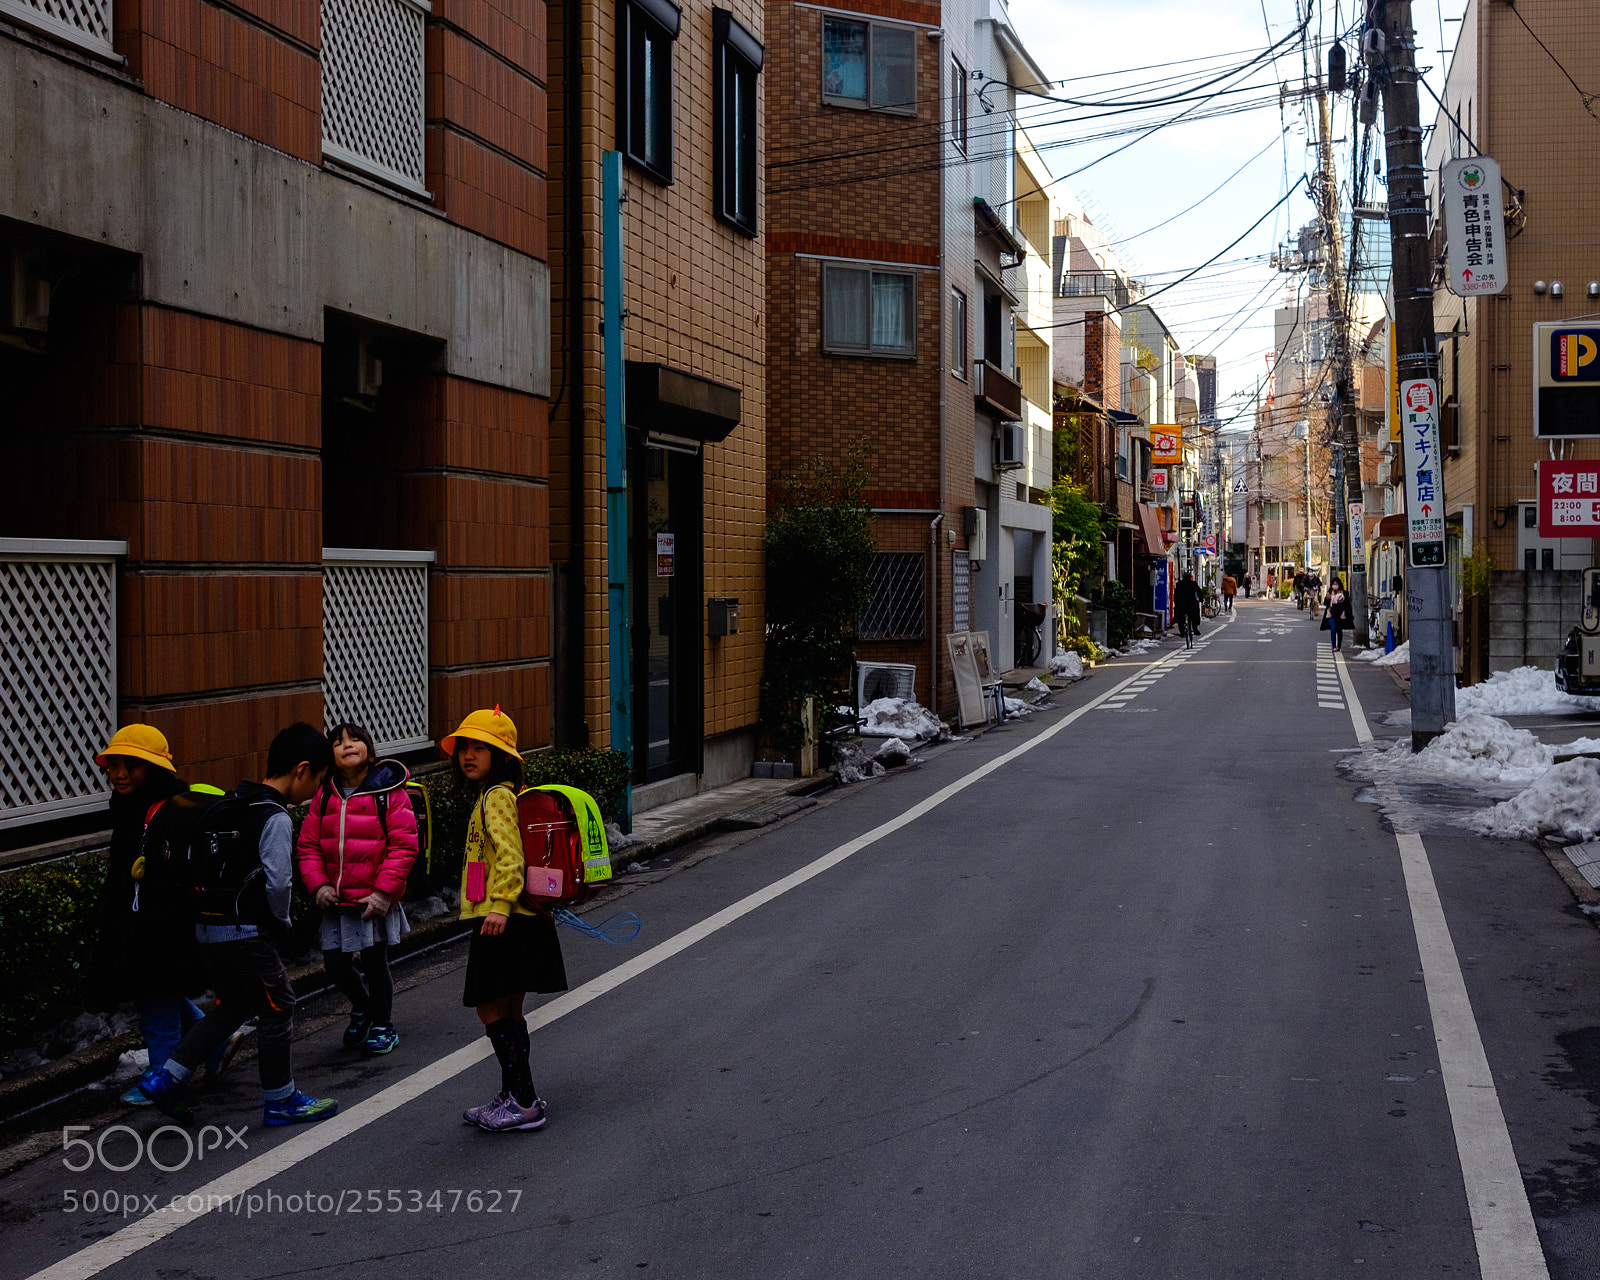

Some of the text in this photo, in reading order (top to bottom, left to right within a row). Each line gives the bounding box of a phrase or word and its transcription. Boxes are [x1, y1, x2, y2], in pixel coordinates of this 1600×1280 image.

[1462, 194, 1483, 267] 青色申告会
[1461, 281, 1498, 291] 3380-8761
[1475, 274, 1496, 282] この先
[1567, 334, 1597, 376] P
[1413, 423, 1435, 502] マキノ質店
[1552, 472, 1598, 494] 夜間
[1553, 501, 1582, 509] 22:00
[1559, 514, 1582, 523] 8:00
